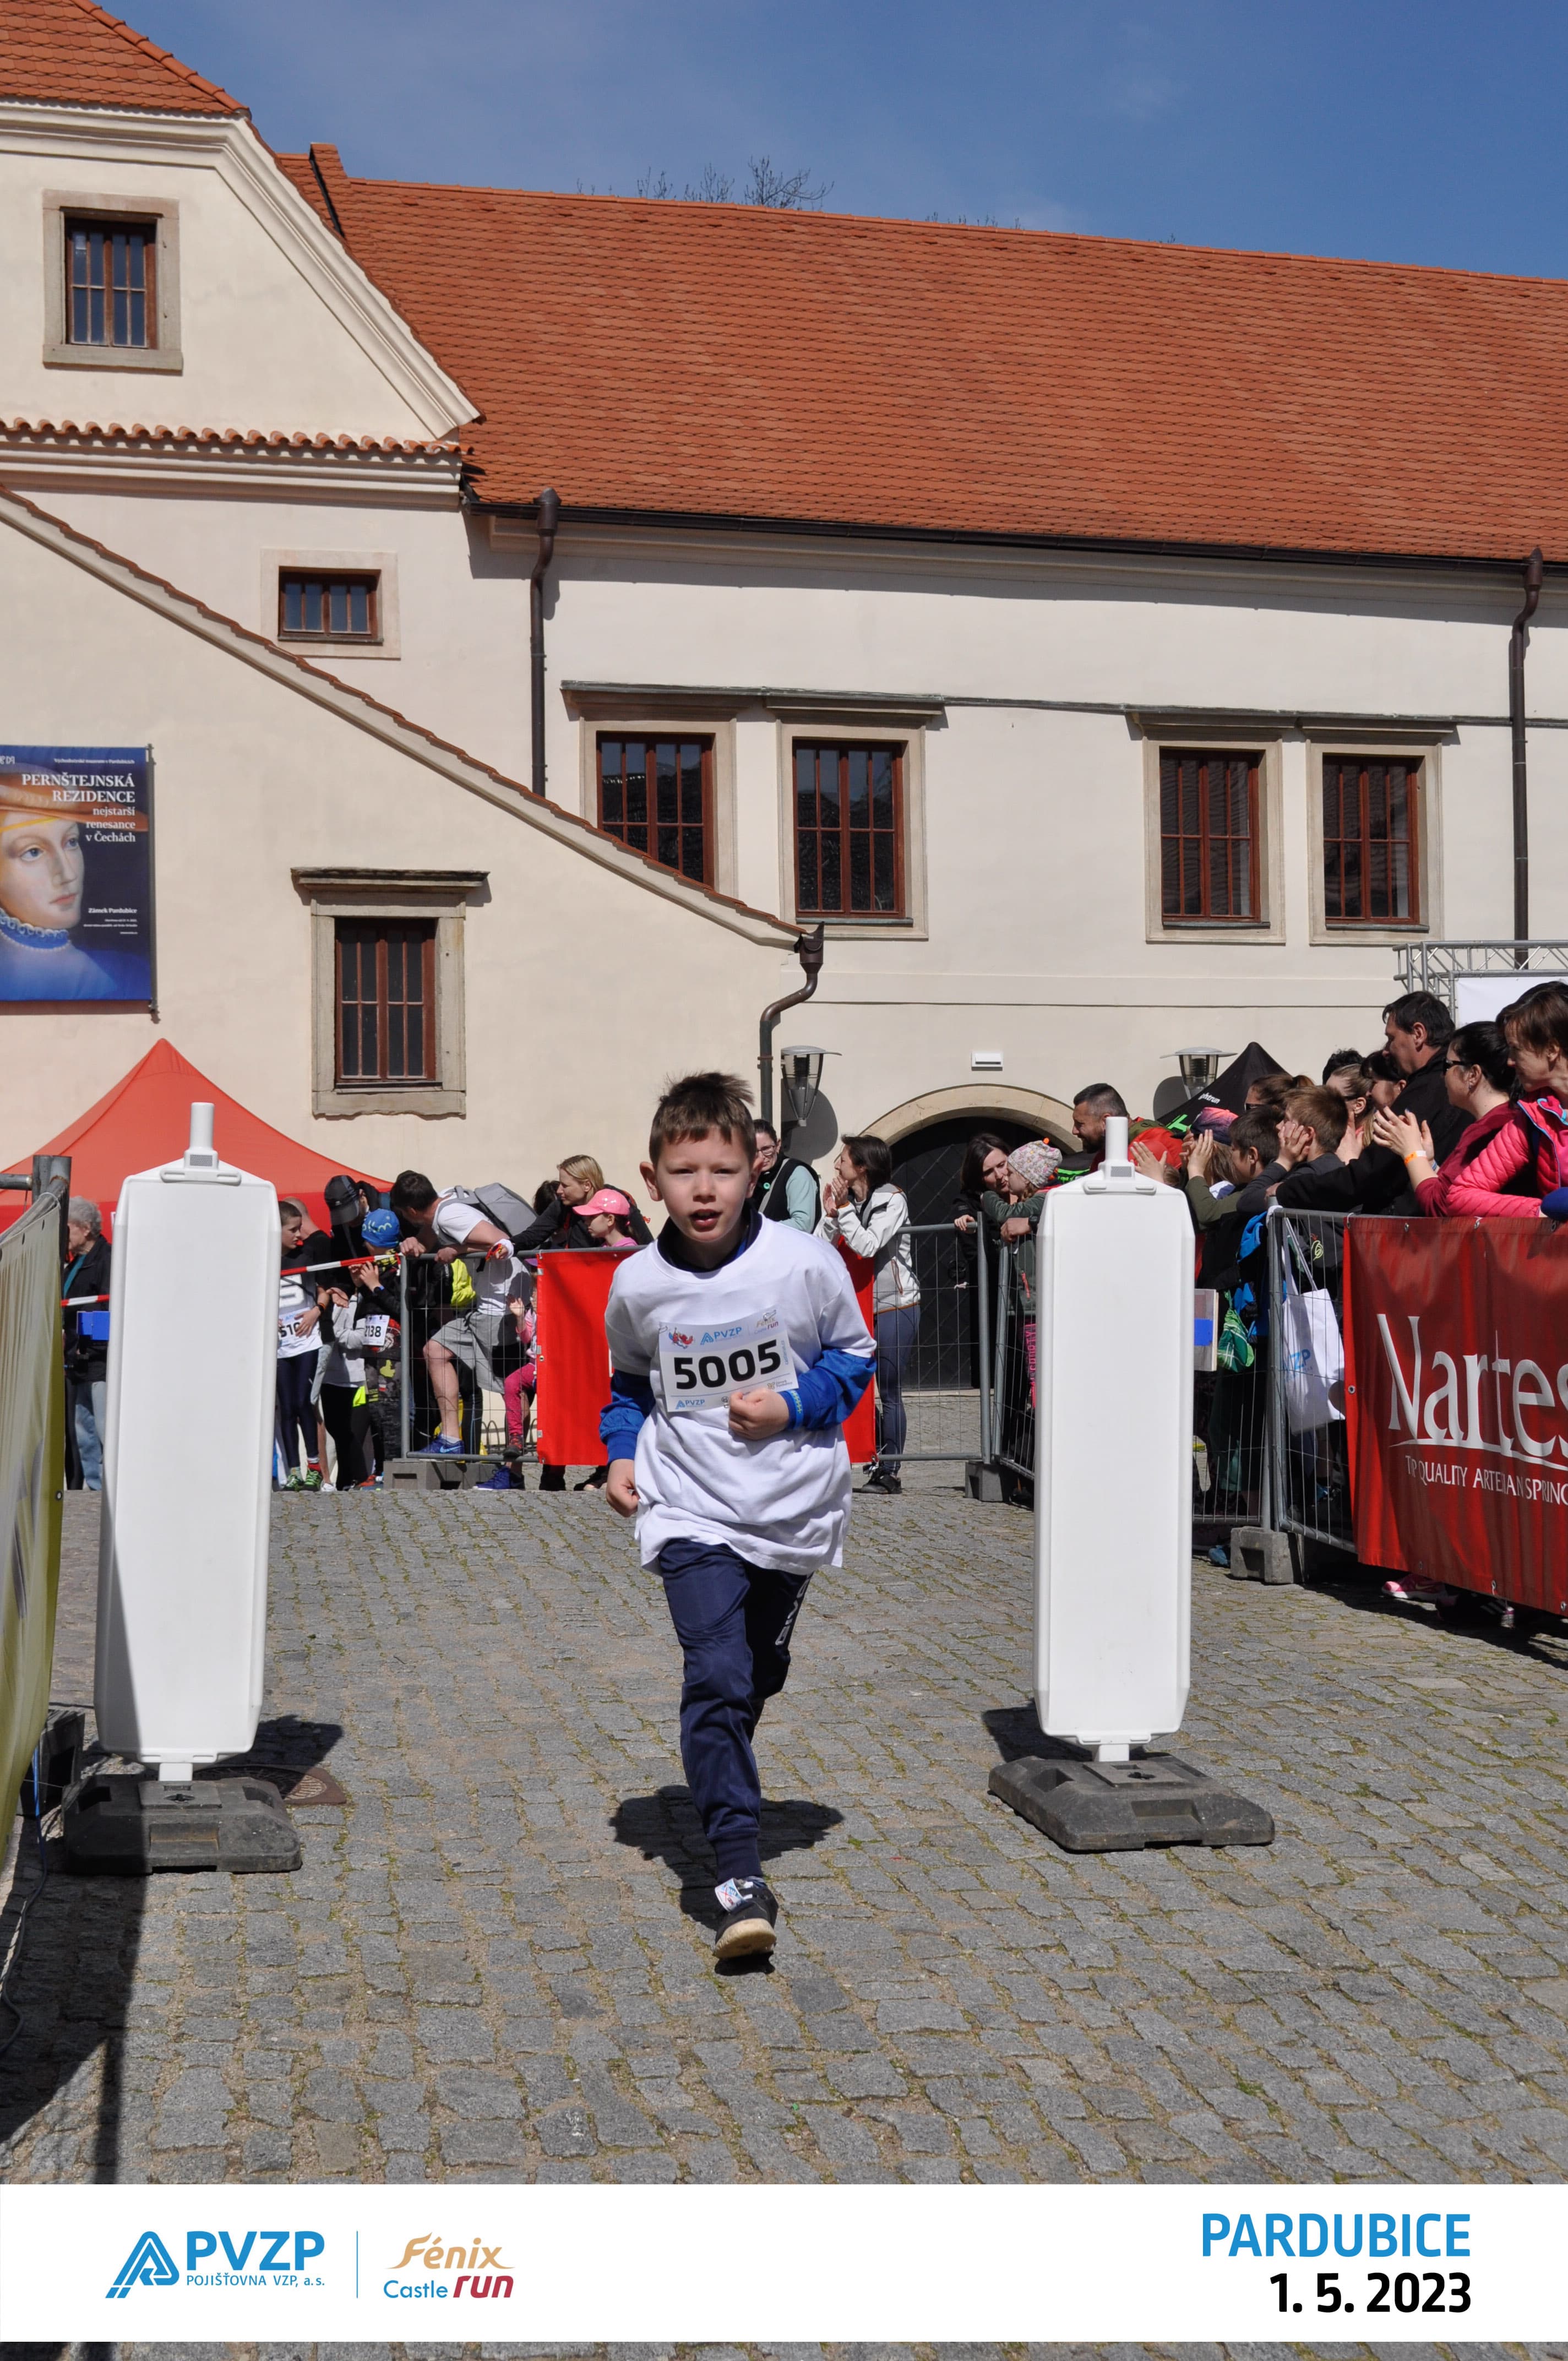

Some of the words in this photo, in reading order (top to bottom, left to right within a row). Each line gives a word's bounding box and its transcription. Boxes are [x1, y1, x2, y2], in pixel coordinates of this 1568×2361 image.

[21, 772, 135, 787] PERNŠTEJNSKÁ
[52, 790, 135, 803] REZIDENCE
[92, 807, 135, 818] nejstarší
[94, 830, 136, 842] Čechách
[767, 1321, 779, 1331] run
[714, 1326, 742, 1340] PVZP
[673, 1339, 781, 1390] 5005
[1418, 1461, 1468, 1486] QUALITY
[1472, 1468, 1524, 1498] ARTEIAN
